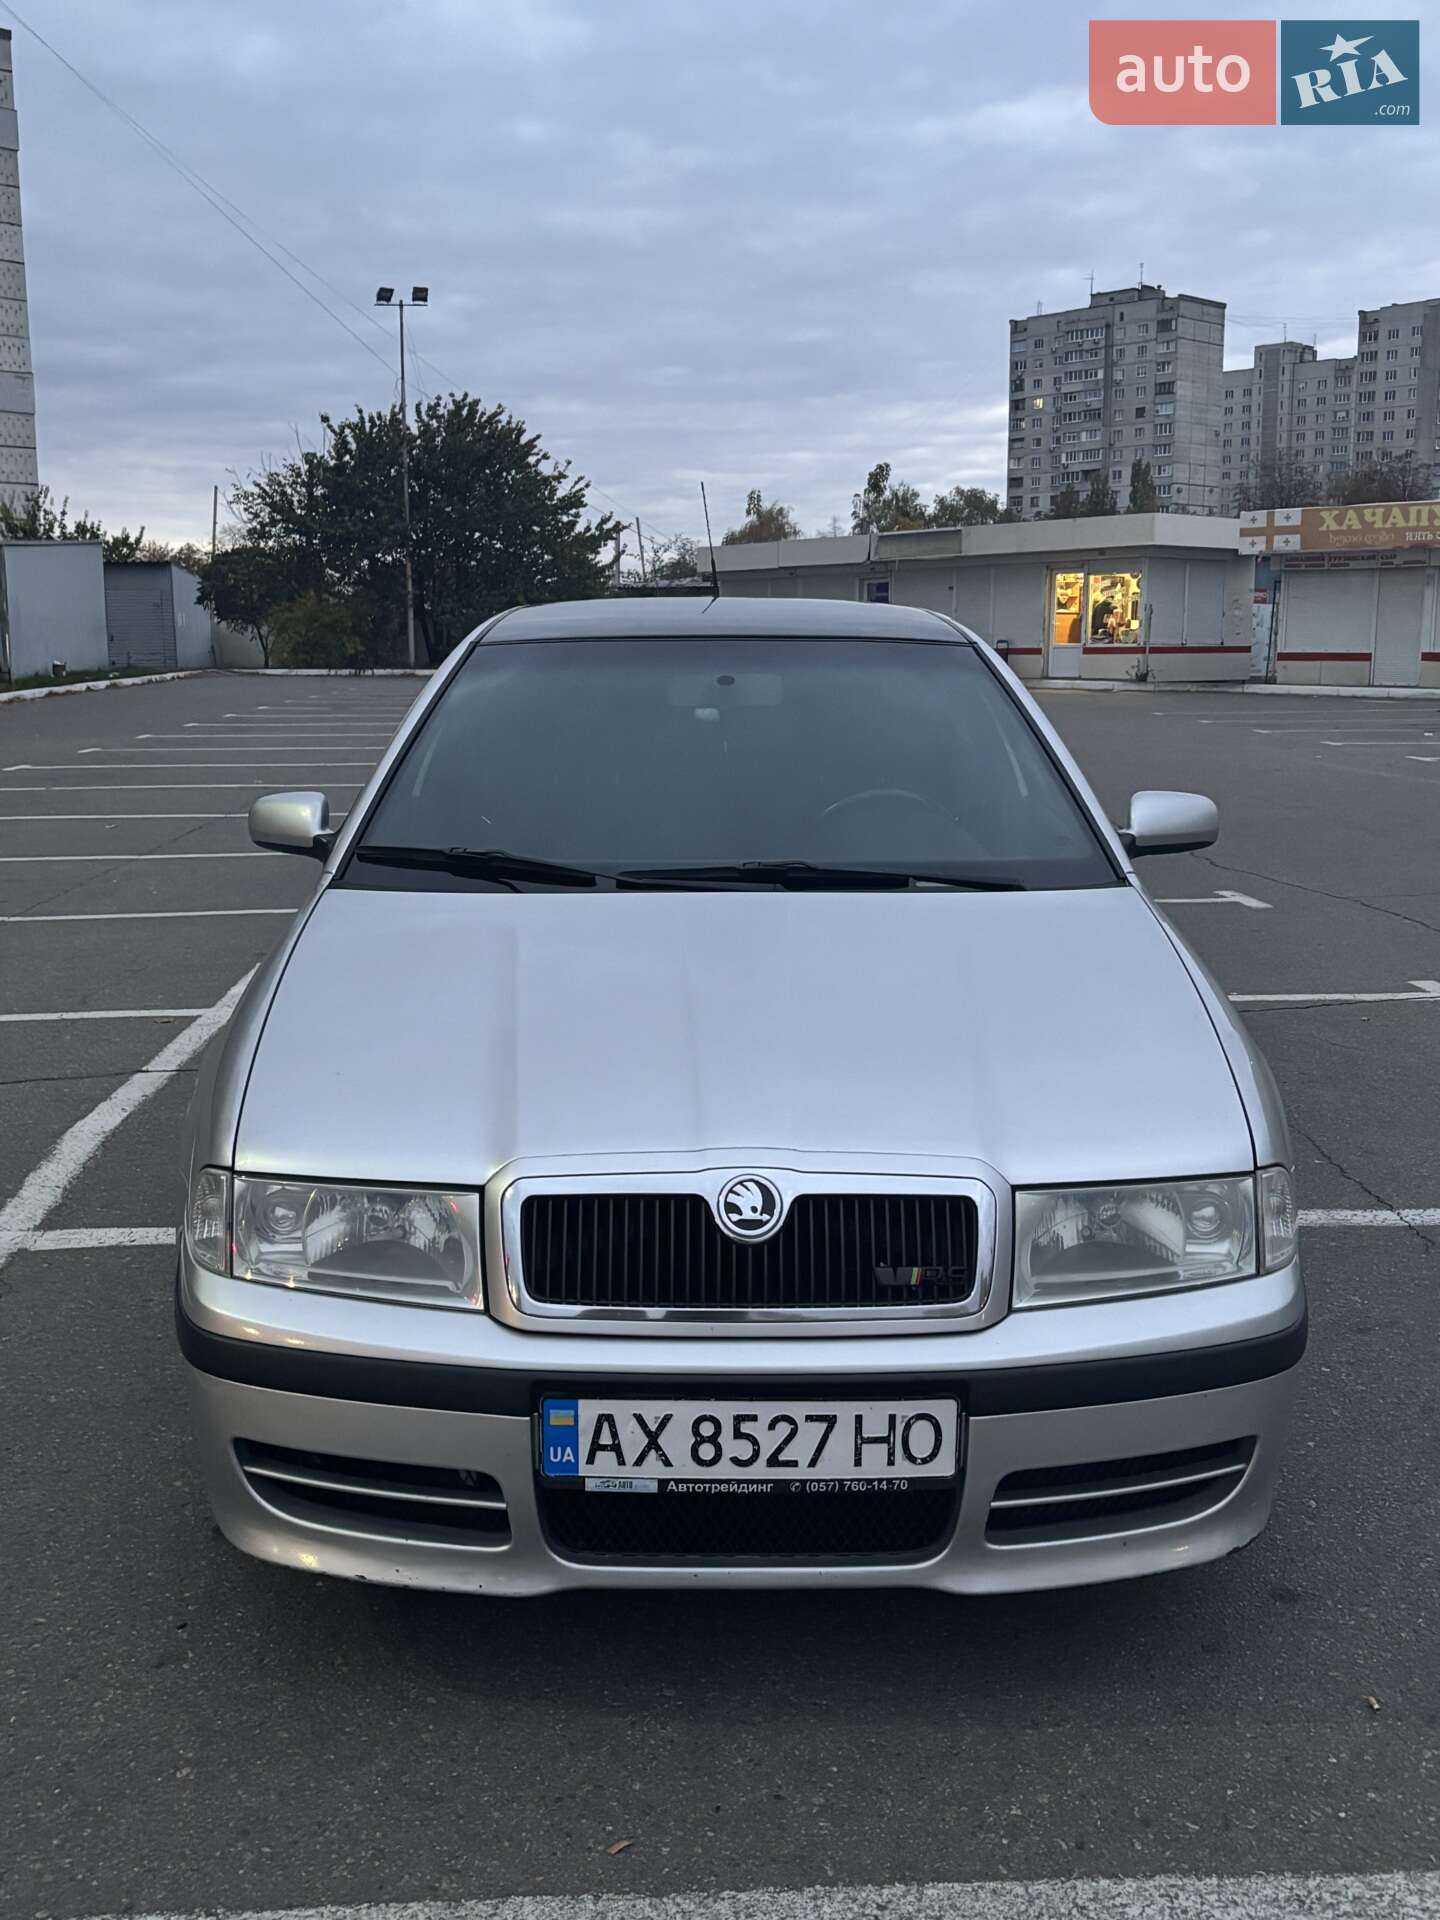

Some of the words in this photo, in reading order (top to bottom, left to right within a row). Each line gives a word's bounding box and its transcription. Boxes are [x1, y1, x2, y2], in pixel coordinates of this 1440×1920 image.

[586, 1413, 674, 1468] AX
[690, 1414, 838, 1468] 8527
[854, 1412, 943, 1468] HO
[549, 1446, 575, 1464] UA
[667, 1480, 774, 1494] Автотрейдинг
[806, 1481, 839, 1493] (057)
[843, 1480, 908, 1492] 760-14-70
